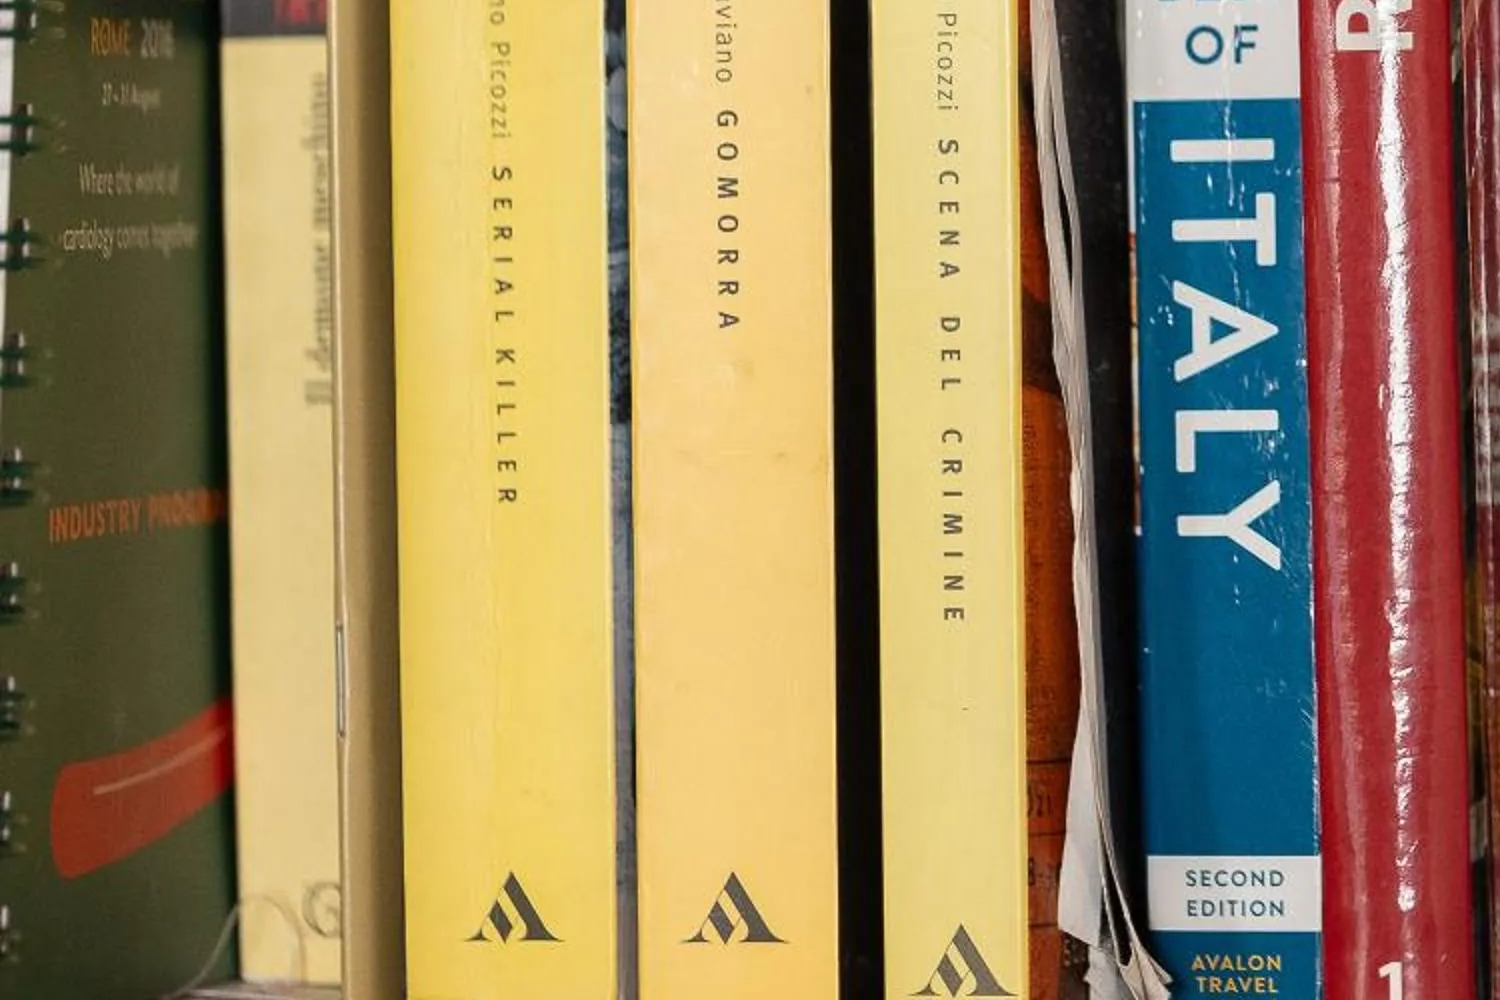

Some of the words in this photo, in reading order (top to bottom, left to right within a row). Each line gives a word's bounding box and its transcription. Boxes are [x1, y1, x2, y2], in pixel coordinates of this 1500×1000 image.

[489, 40, 513, 139] Picozzi
[936, 12, 959, 112] Picozzi
[1186, 24, 1259, 65] OF
[491, 165, 515, 322] SERIAL
[716, 108, 741, 330] GOMORRA
[937, 139, 961, 279] SCENA
[940, 316, 962, 391] DEL
[1169, 137, 1282, 571] ITALY
[495, 348, 518, 504] KILLER
[49, 499, 142, 545] INDUSTRY
[941, 428, 965, 620] CRIMINE
[1185, 869, 1285, 888] SECOND
[1187, 899, 1286, 917] EDITION
[1191, 954, 1283, 972] AVALON
[1196, 976, 1280, 994] TRAVEL
